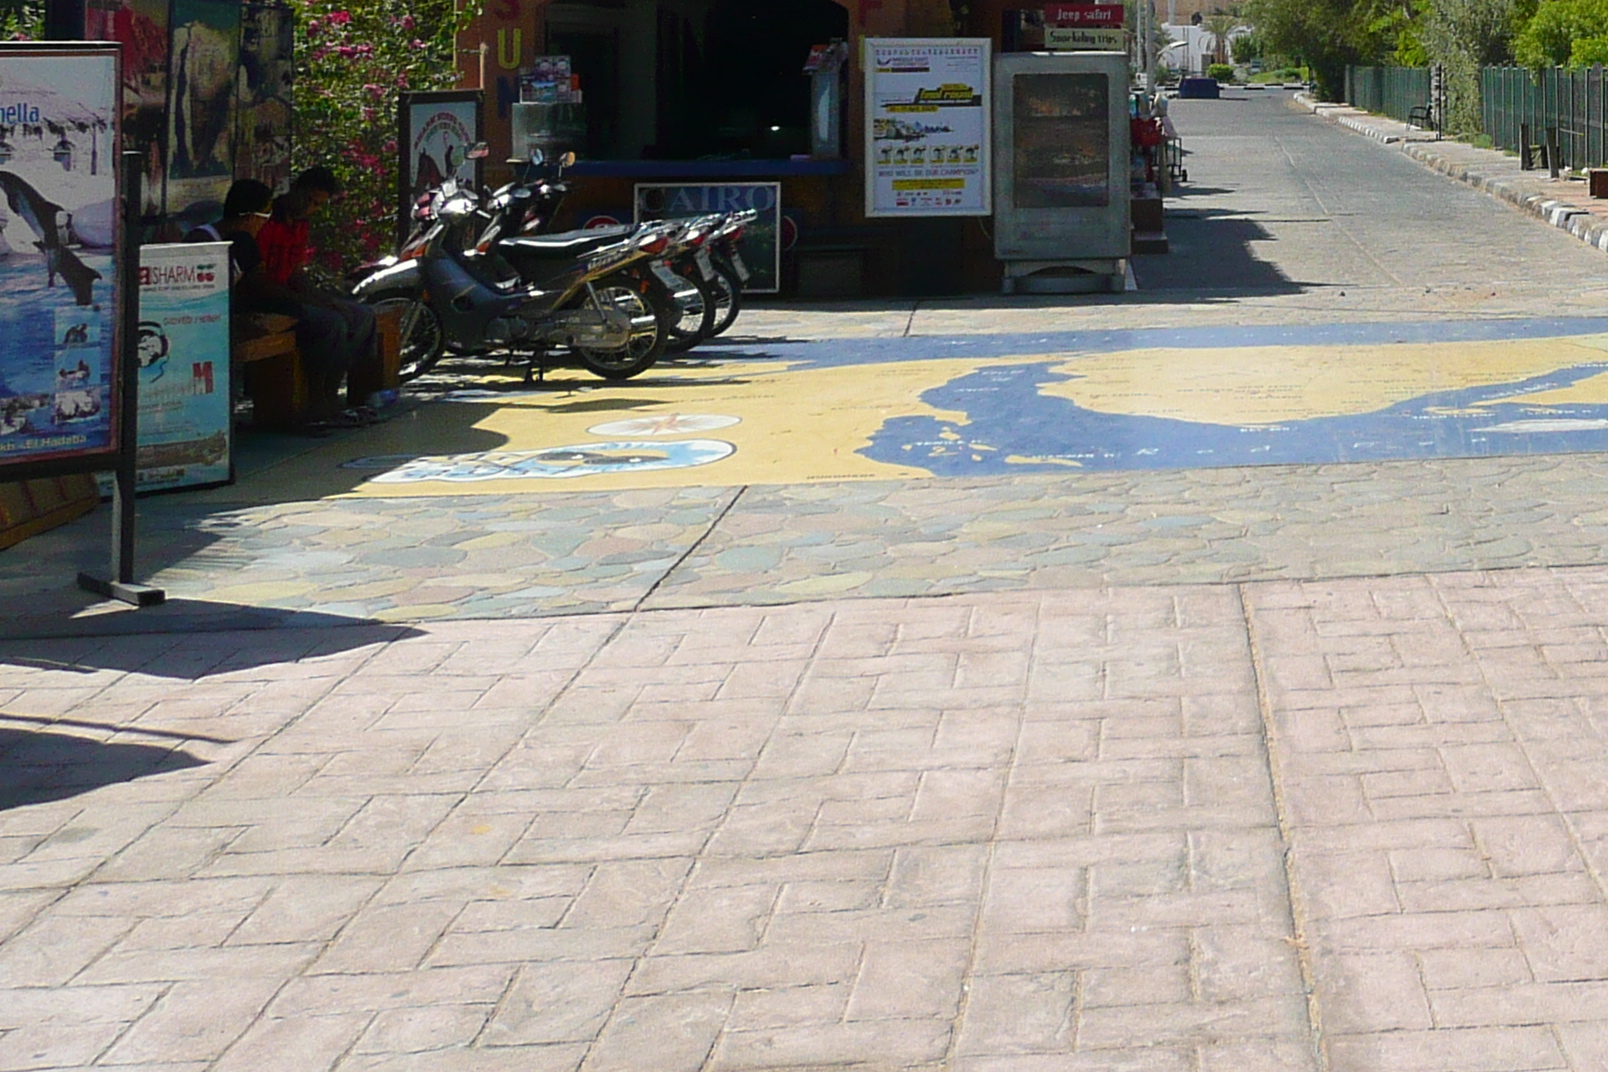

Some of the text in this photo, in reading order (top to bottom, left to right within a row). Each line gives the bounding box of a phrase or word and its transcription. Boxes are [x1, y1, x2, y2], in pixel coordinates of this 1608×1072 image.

[1056, 8, 1111, 22] Jeep safari
[638, 185, 775, 213] CAIRO
[151, 265, 196, 286] SHARM
